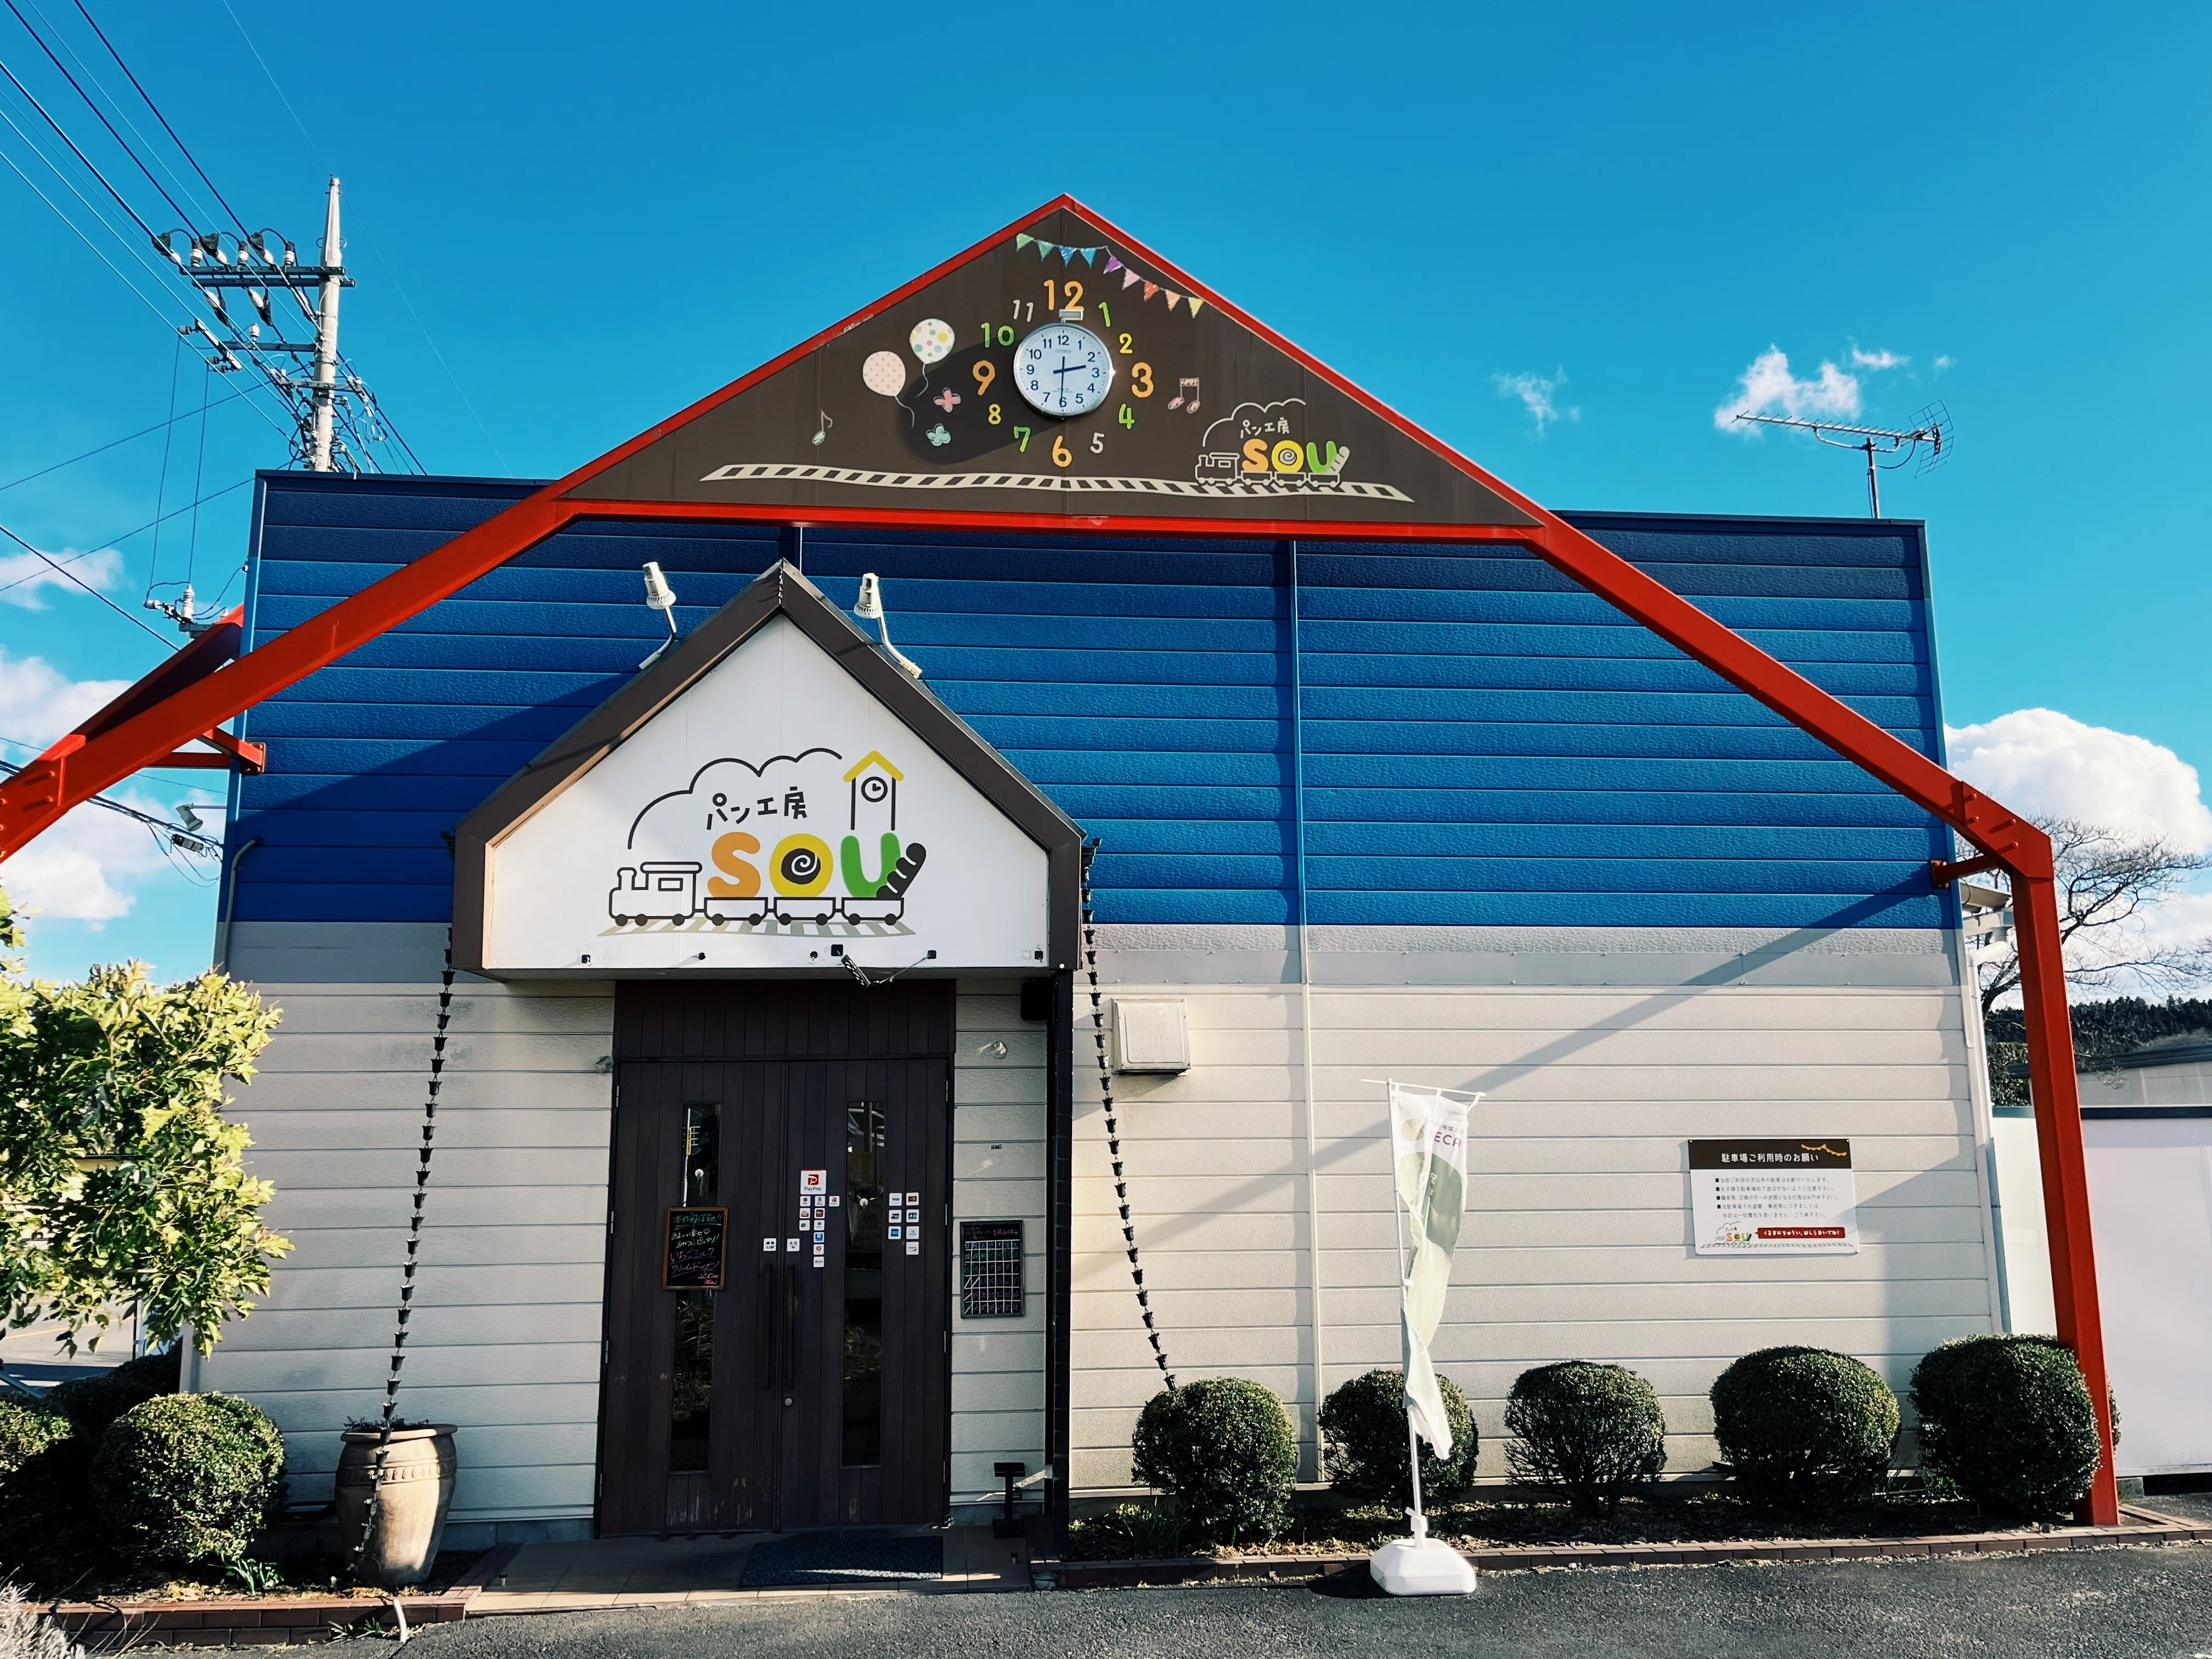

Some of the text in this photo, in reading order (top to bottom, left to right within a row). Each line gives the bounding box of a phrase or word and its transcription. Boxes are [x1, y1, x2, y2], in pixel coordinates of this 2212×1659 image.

[1043, 279, 1084, 311] 12
[1013, 299, 1034, 322] 11
[1098, 302, 1111, 328] 1
[981, 323, 1015, 348] 10
[1042, 338, 1052, 349] 11
[1057, 335, 1069, 346] 12
[1077, 340, 1081, 350] 1
[1119, 333, 1133, 354] 2
[1029, 349, 1042, 359] 10
[1087, 352, 1095, 362] 2
[972, 360, 995, 396] 9
[1026, 364, 1034, 375] 9
[1092, 367, 1099, 378] 3
[1131, 362, 1154, 398] 3
[1030, 380, 1039, 391] 8
[1087, 383, 1095, 393] 4
[1043, 392, 1051, 402] 7
[1059, 397, 1067, 407] 6
[1075, 393, 1084, 404] 5
[988, 404, 1001, 425] 8
[1118, 404, 1135, 430] 4
[1240, 417, 1290, 439] パン工房
[1013, 426, 1030, 453] 7
[1090, 432, 1105, 454] 5
[1052, 435, 1073, 467] 6
[1242, 438, 1350, 475] SOU
[707, 786, 807, 830] パン工房
[707, 831, 926, 899] SOU
[1721, 1153, 1819, 1163] 駐車場ご利用時のお願い
